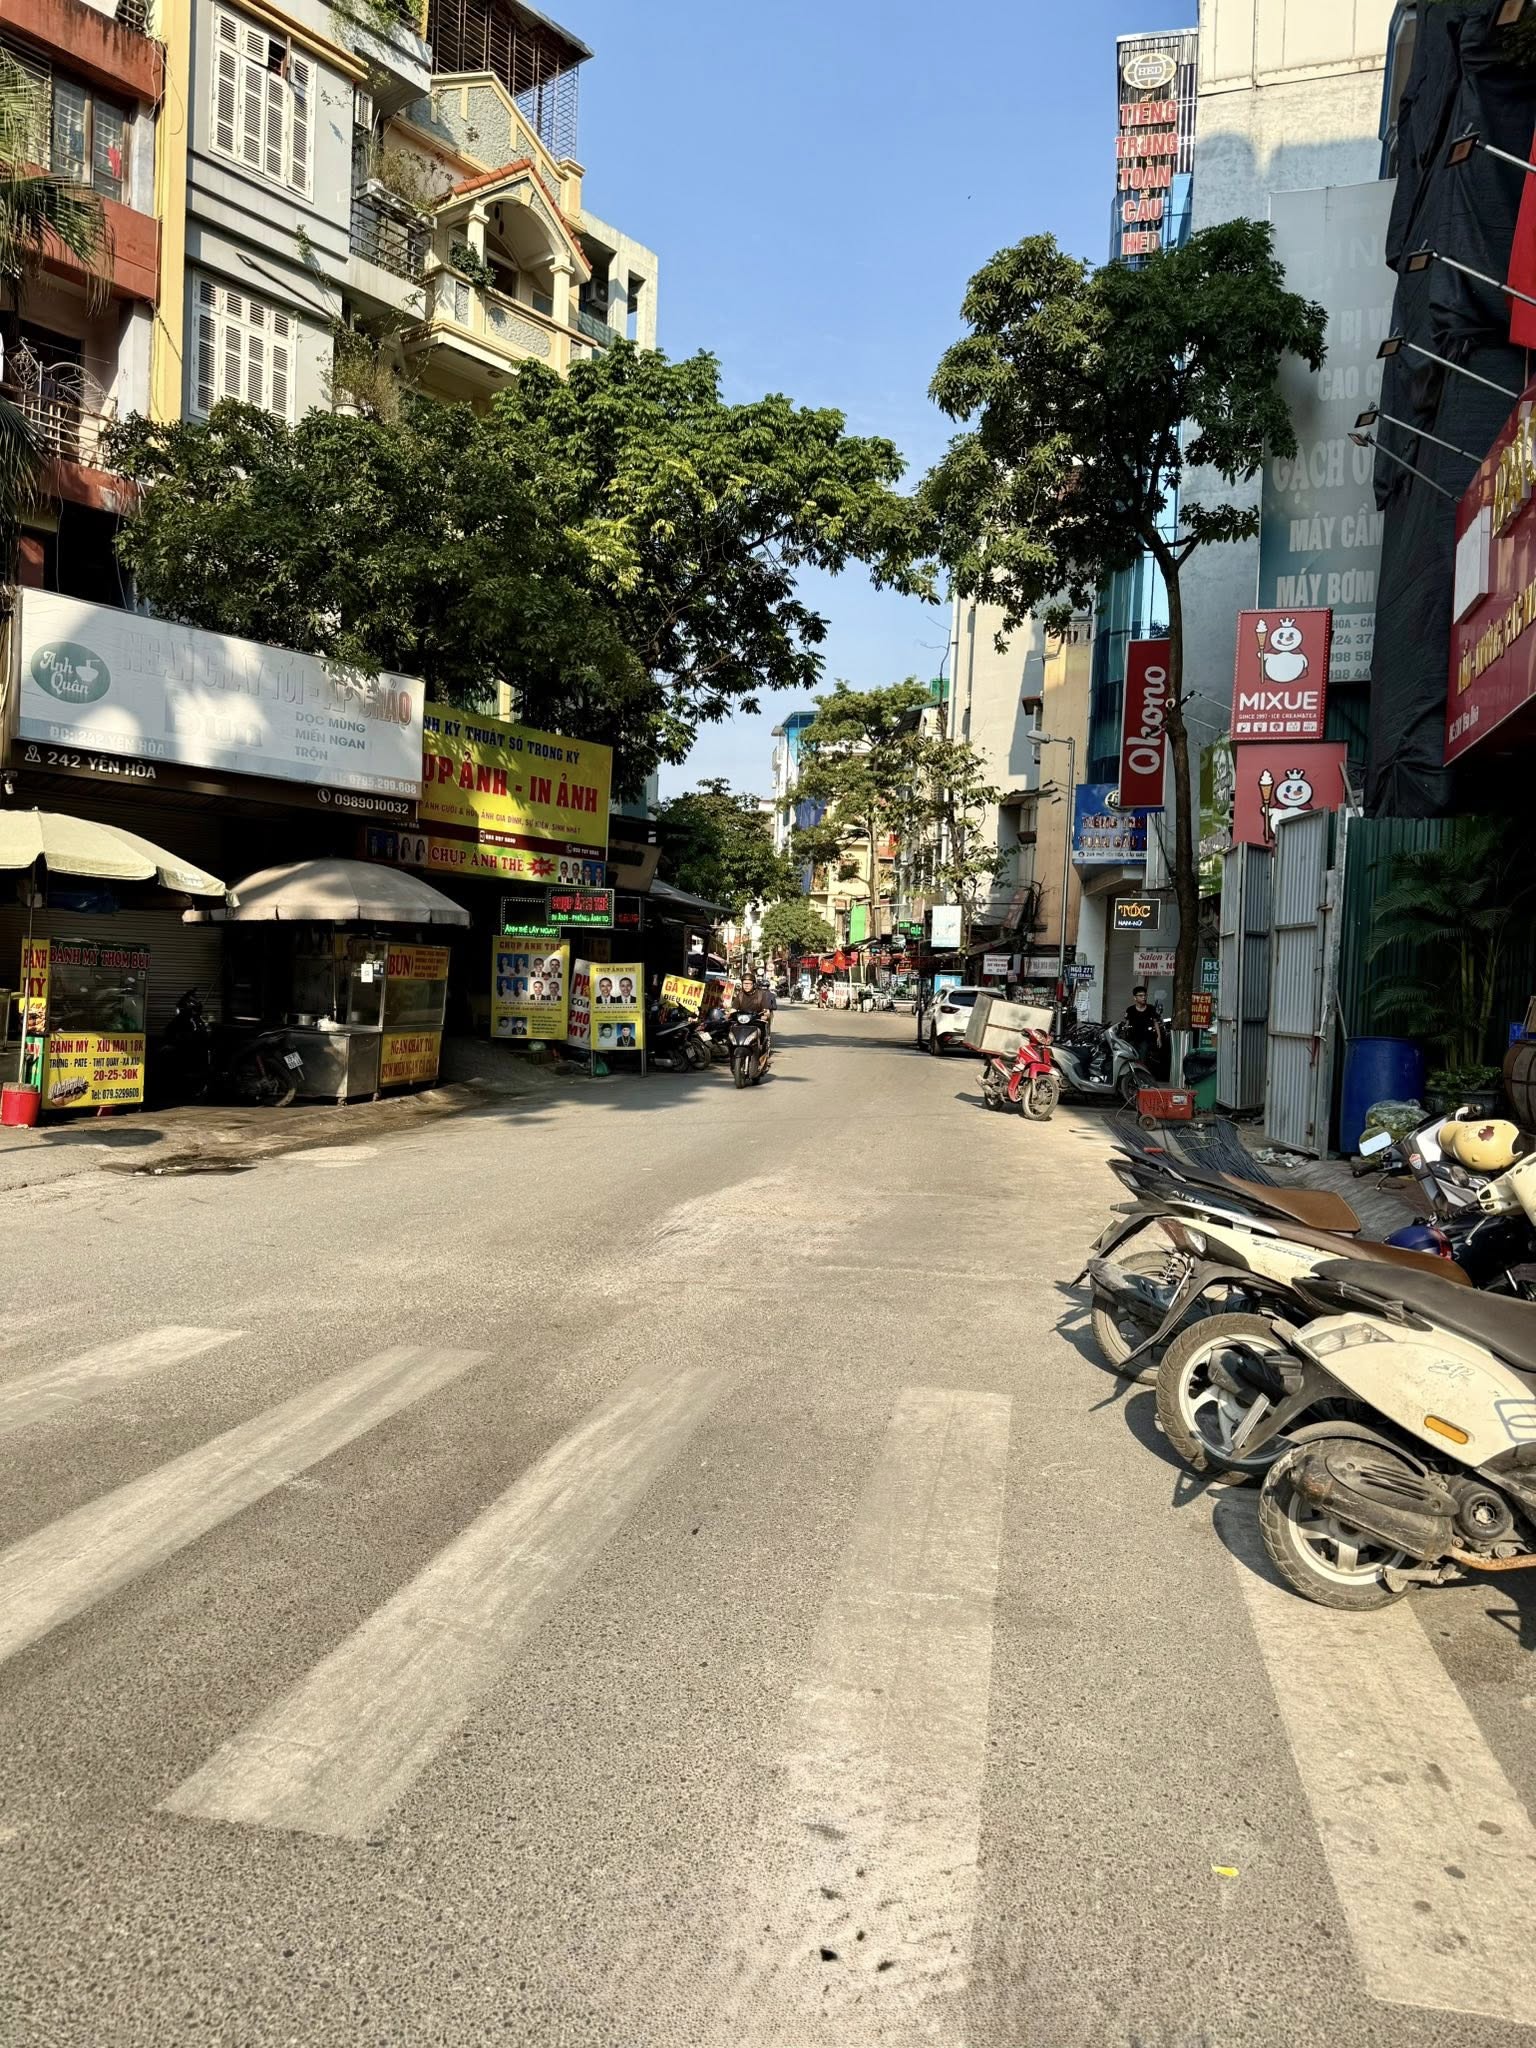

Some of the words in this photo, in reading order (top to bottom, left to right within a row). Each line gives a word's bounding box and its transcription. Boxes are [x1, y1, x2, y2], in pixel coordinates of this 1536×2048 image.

[1138, 66, 1163, 77] HED
[1120, 94, 1178, 127] TIẾNG
[1115, 132, 1179, 160] TRUNG
[1120, 156, 1171, 190] TOÀN
[1122, 189, 1164, 223] CẦU
[1122, 231, 1161, 256] HED
[1317, 365, 1360, 401] CAO
[1272, 437, 1347, 504] GẠCH
[1289, 512, 1337, 554] MÁY
[1341, 503, 1384, 549] CẦM
[1276, 569, 1322, 609] MÁY
[1327, 568, 1375, 605] BƠM
[1335, 635, 1352, 646] 24
[1356, 633, 1372, 645] 37
[40, 651, 74, 675] Anh
[1355, 651, 1371, 662] 58
[51, 674, 89, 695] Quân
[1354, 668, 1370, 679] 44
[1239, 691, 1319, 711] MIXUE
[296, 711, 325, 727] DỌC
[328, 715, 366, 733] MÙNG
[1126, 666, 1166, 775] Okono
[295, 745, 328, 761] TRỘN
[329, 735, 365, 750] NGAN
[465, 725, 505, 748] THUẬT
[509, 735, 523, 753] SỐ
[528, 741, 563, 762] TRỌNG
[47, 752, 81, 769] 242
[88, 754, 120, 773] YÊN
[125, 759, 157, 779] HÒA
[459, 751, 508, 796] ẢNH
[530, 776, 552, 804] IN
[556, 772, 599, 813] ẢNH
[335, 793, 409, 814] 0989010032
[431, 846, 467, 869] CHỤP
[470, 848, 497, 871] ẢNH
[1118, 902, 1151, 918] TÓC
[539, 926, 558, 935] NGAY
[23, 944, 48, 969] BÁNH
[49, 942, 81, 965] BÁNH
[1139, 952, 1163, 961] Salon
[1204, 971, 1218, 983] RIÊ
[50, 1038, 74, 1054] BÁNH
[112, 1040, 128, 1055] MẠI
[130, 1039, 144, 1052] 18K
[106, 1057, 119, 1068] QUAY
[94, 1068, 138, 1082] 20-25-30K
[91, 1089, 102, 1101] Tel:
